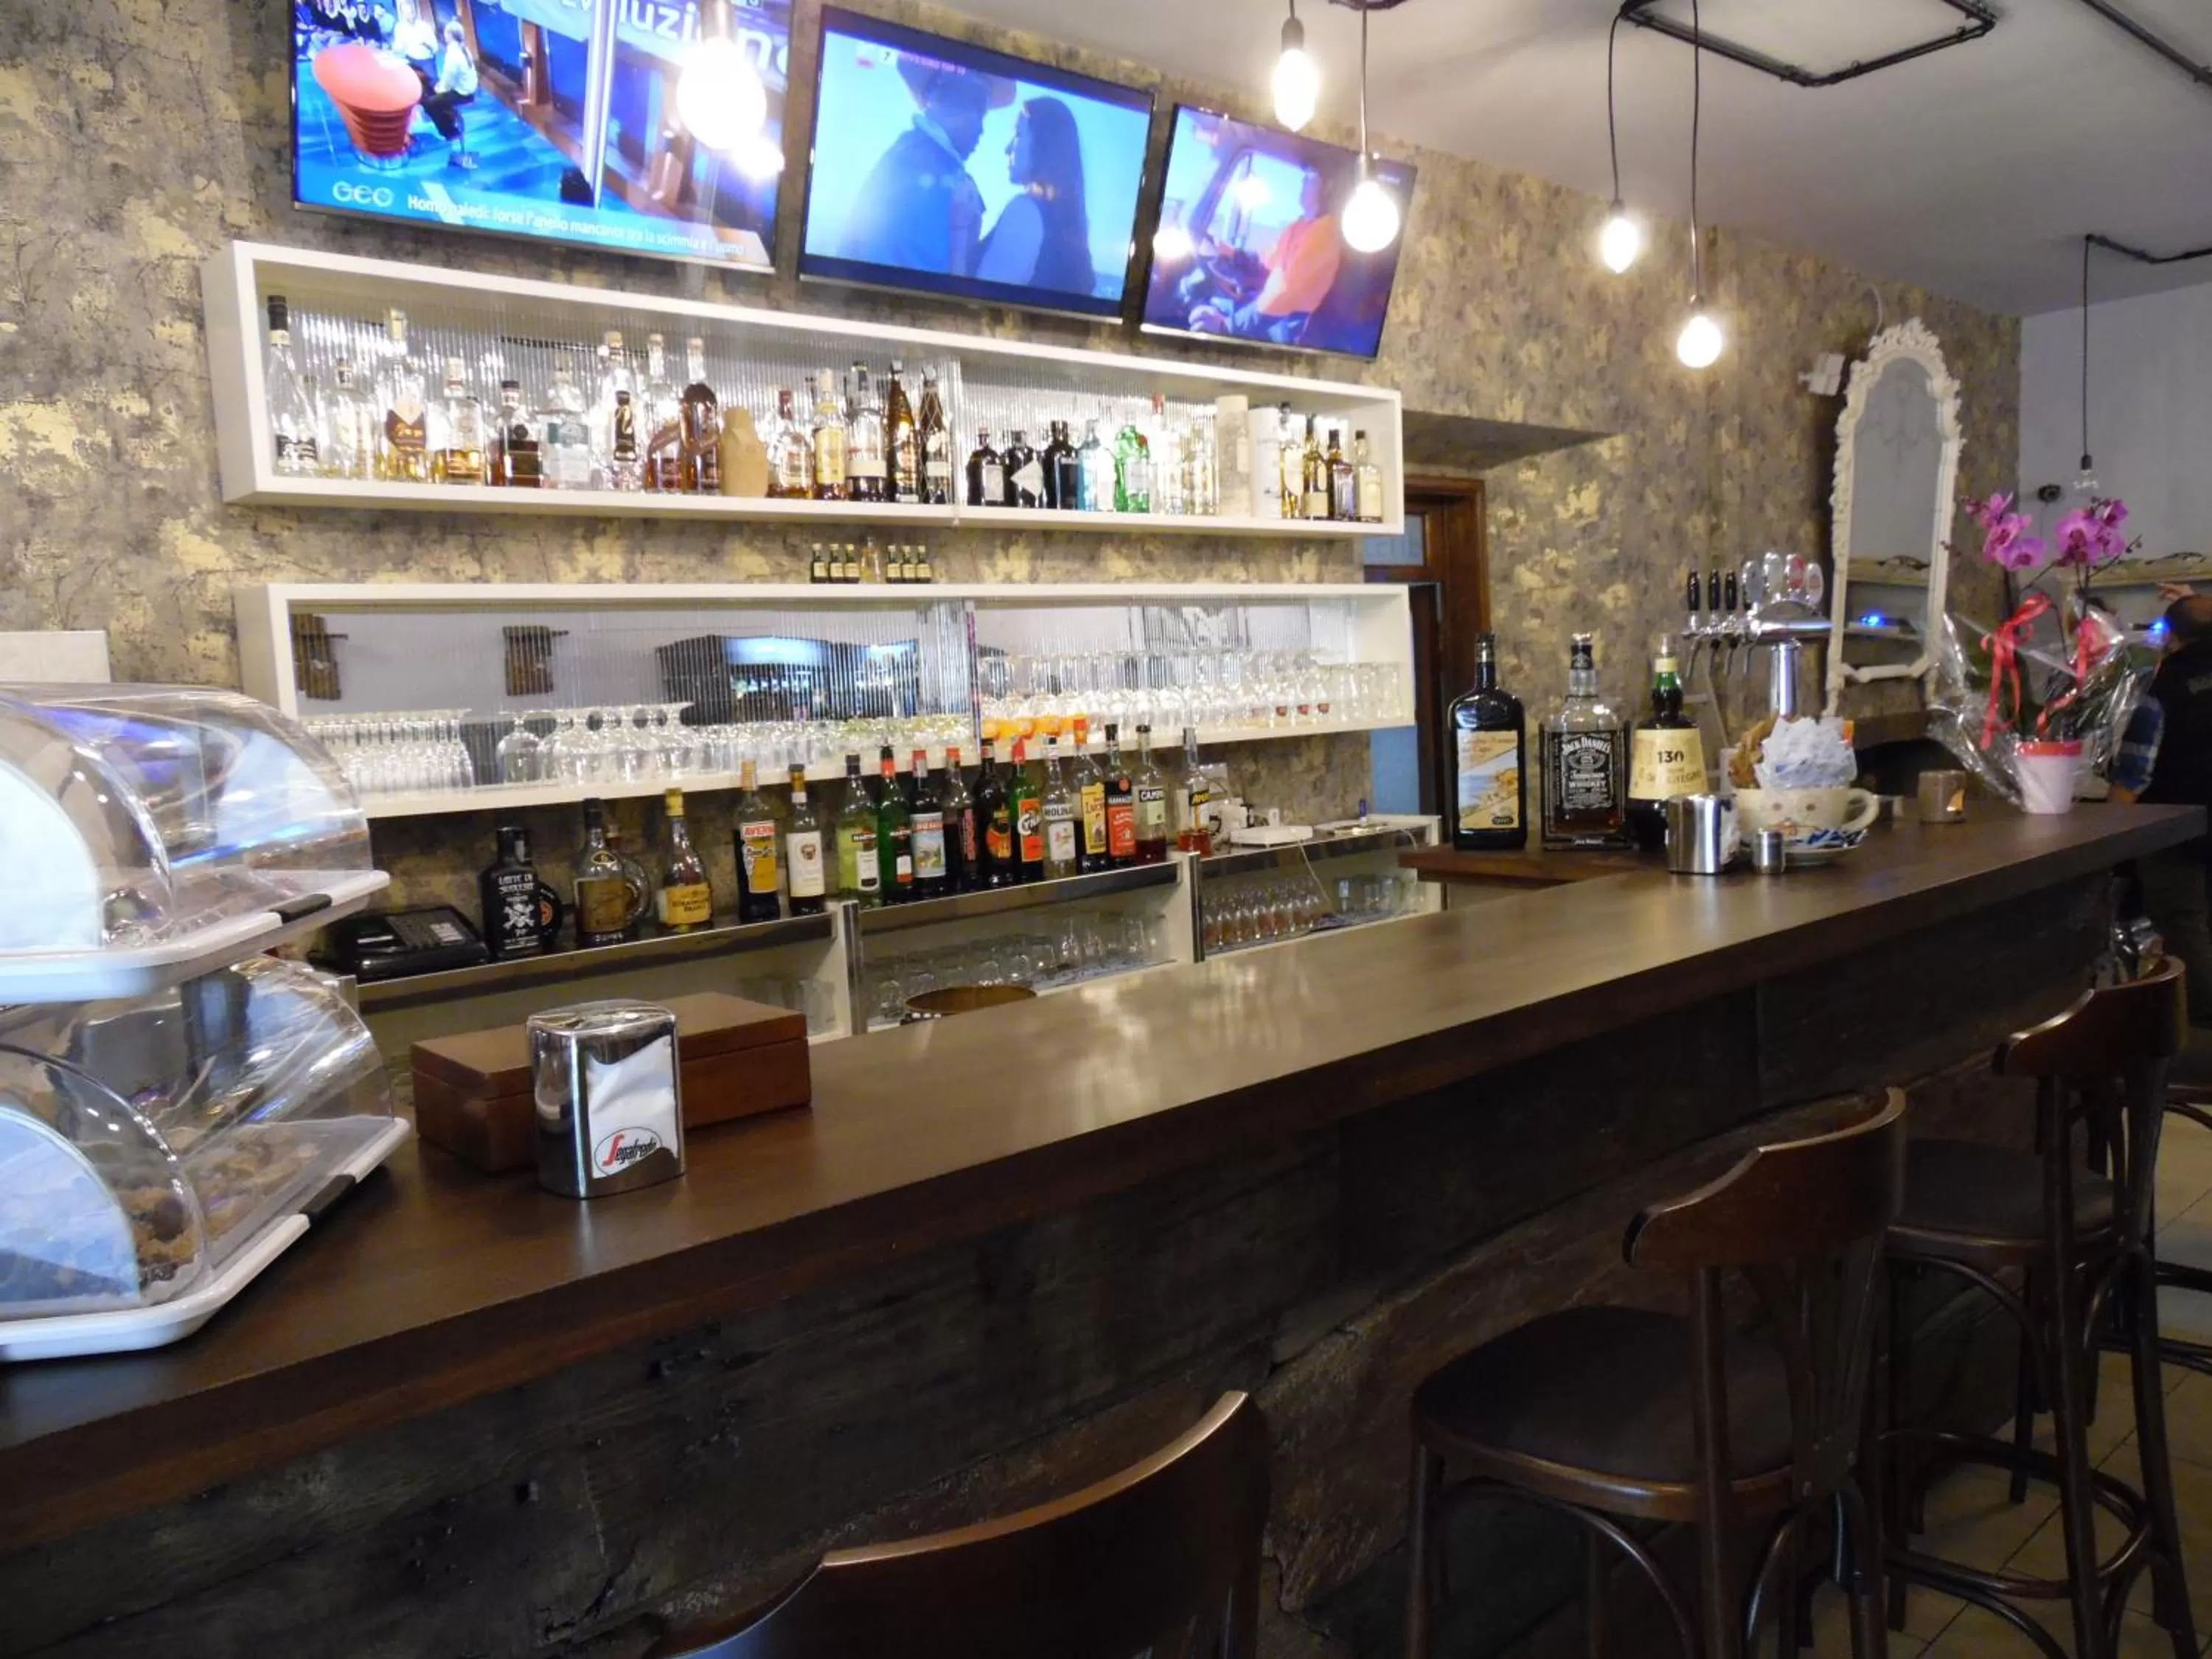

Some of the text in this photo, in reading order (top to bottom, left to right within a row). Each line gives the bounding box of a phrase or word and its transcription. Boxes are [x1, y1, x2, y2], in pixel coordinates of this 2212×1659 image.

[333, 181, 394, 207] GEO
[1562, 740, 1580, 755] JACK
[1657, 750, 1684, 764] 130
